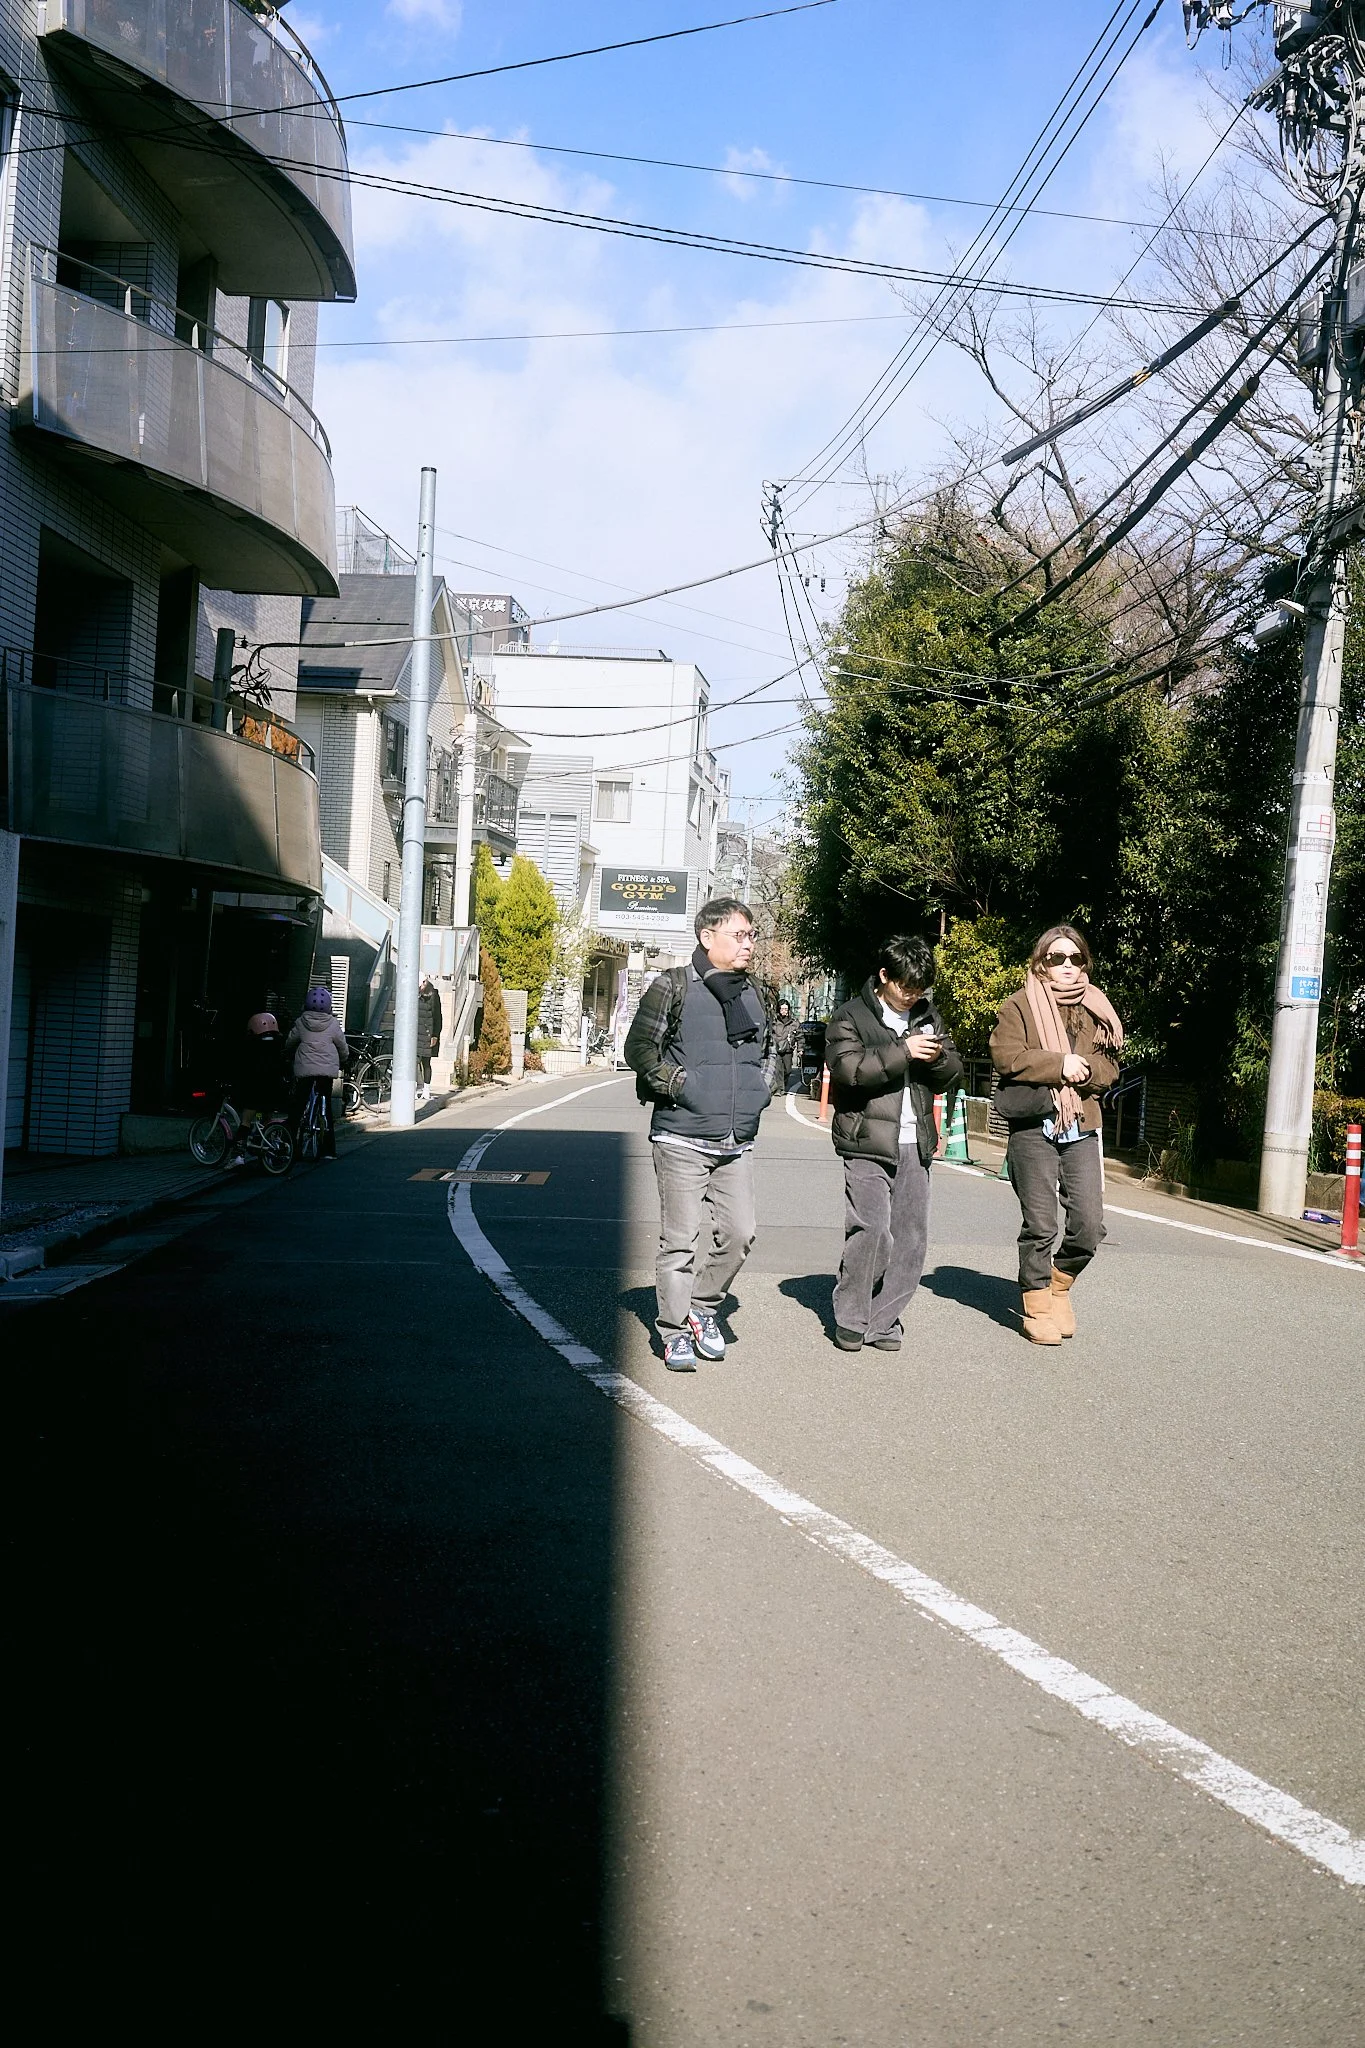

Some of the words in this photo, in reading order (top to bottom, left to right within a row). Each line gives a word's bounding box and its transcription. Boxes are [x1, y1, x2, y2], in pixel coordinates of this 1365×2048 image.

[617, 874, 648, 882] FITNESS
[611, 883, 676, 893] GOLD'S
[622, 891, 665, 900] GYM
[627, 900, 658, 912] Premium
